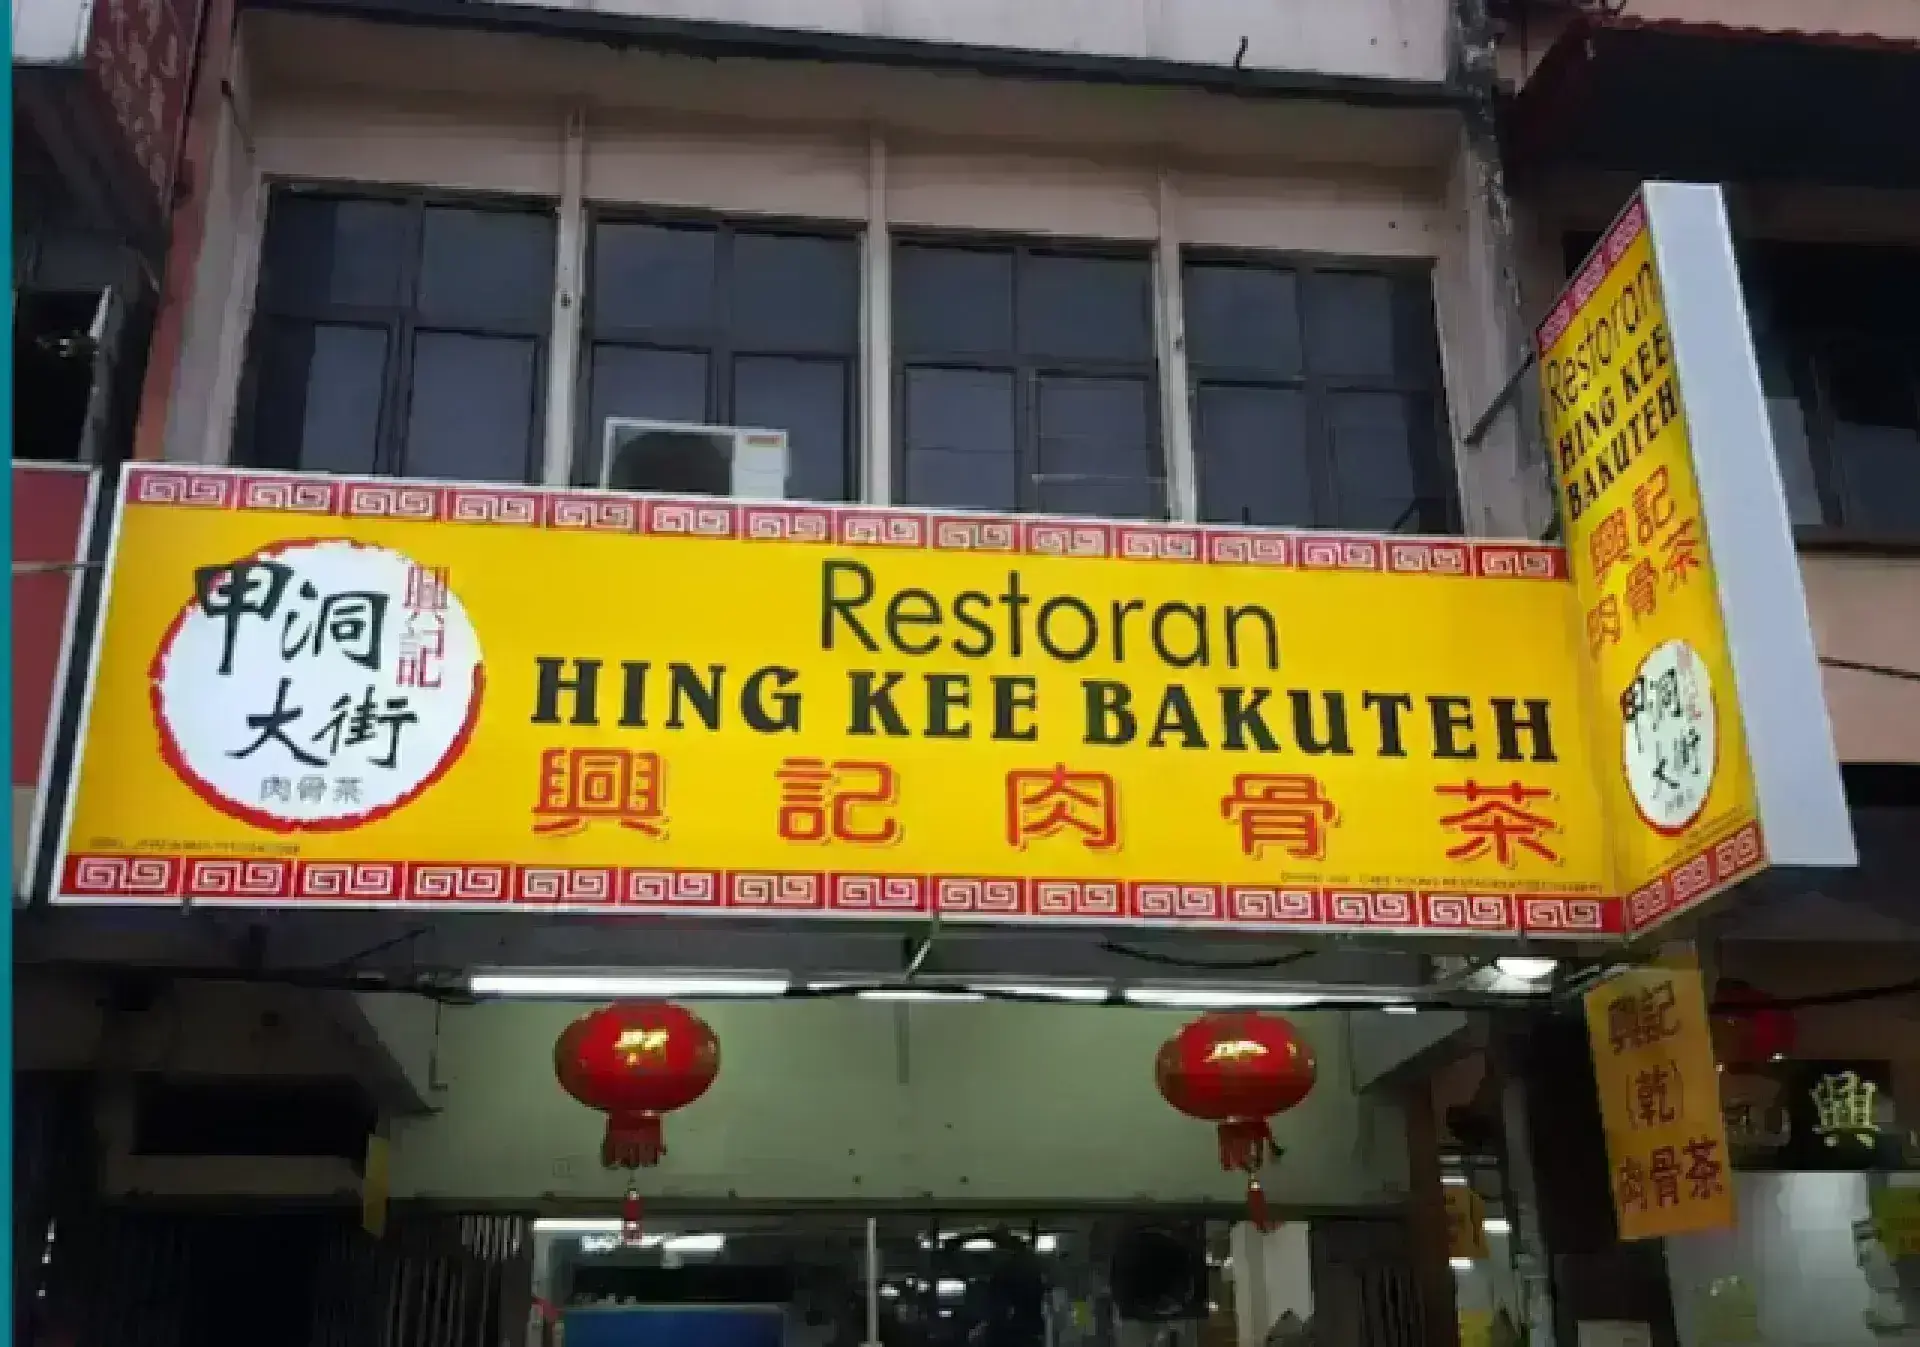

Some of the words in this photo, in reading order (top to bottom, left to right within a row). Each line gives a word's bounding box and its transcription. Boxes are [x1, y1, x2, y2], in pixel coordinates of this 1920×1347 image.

[1548, 261, 1658, 422] Restoran
[1558, 386, 1617, 474] HING
[1620, 323, 1669, 402] KEE
[1566, 376, 1679, 522] BAKUTEH
[193, 560, 390, 676] 甲洞
[820, 557, 1280, 671] Restoran
[226, 678, 418, 768] 大街
[530, 656, 803, 733] HING
[845, 670, 1039, 742] KEE
[1080, 678, 1559, 764] BAKUTEH
[259, 774, 365, 805] 肉骨茶
[530, 746, 1568, 870] 興記肉骨茶
